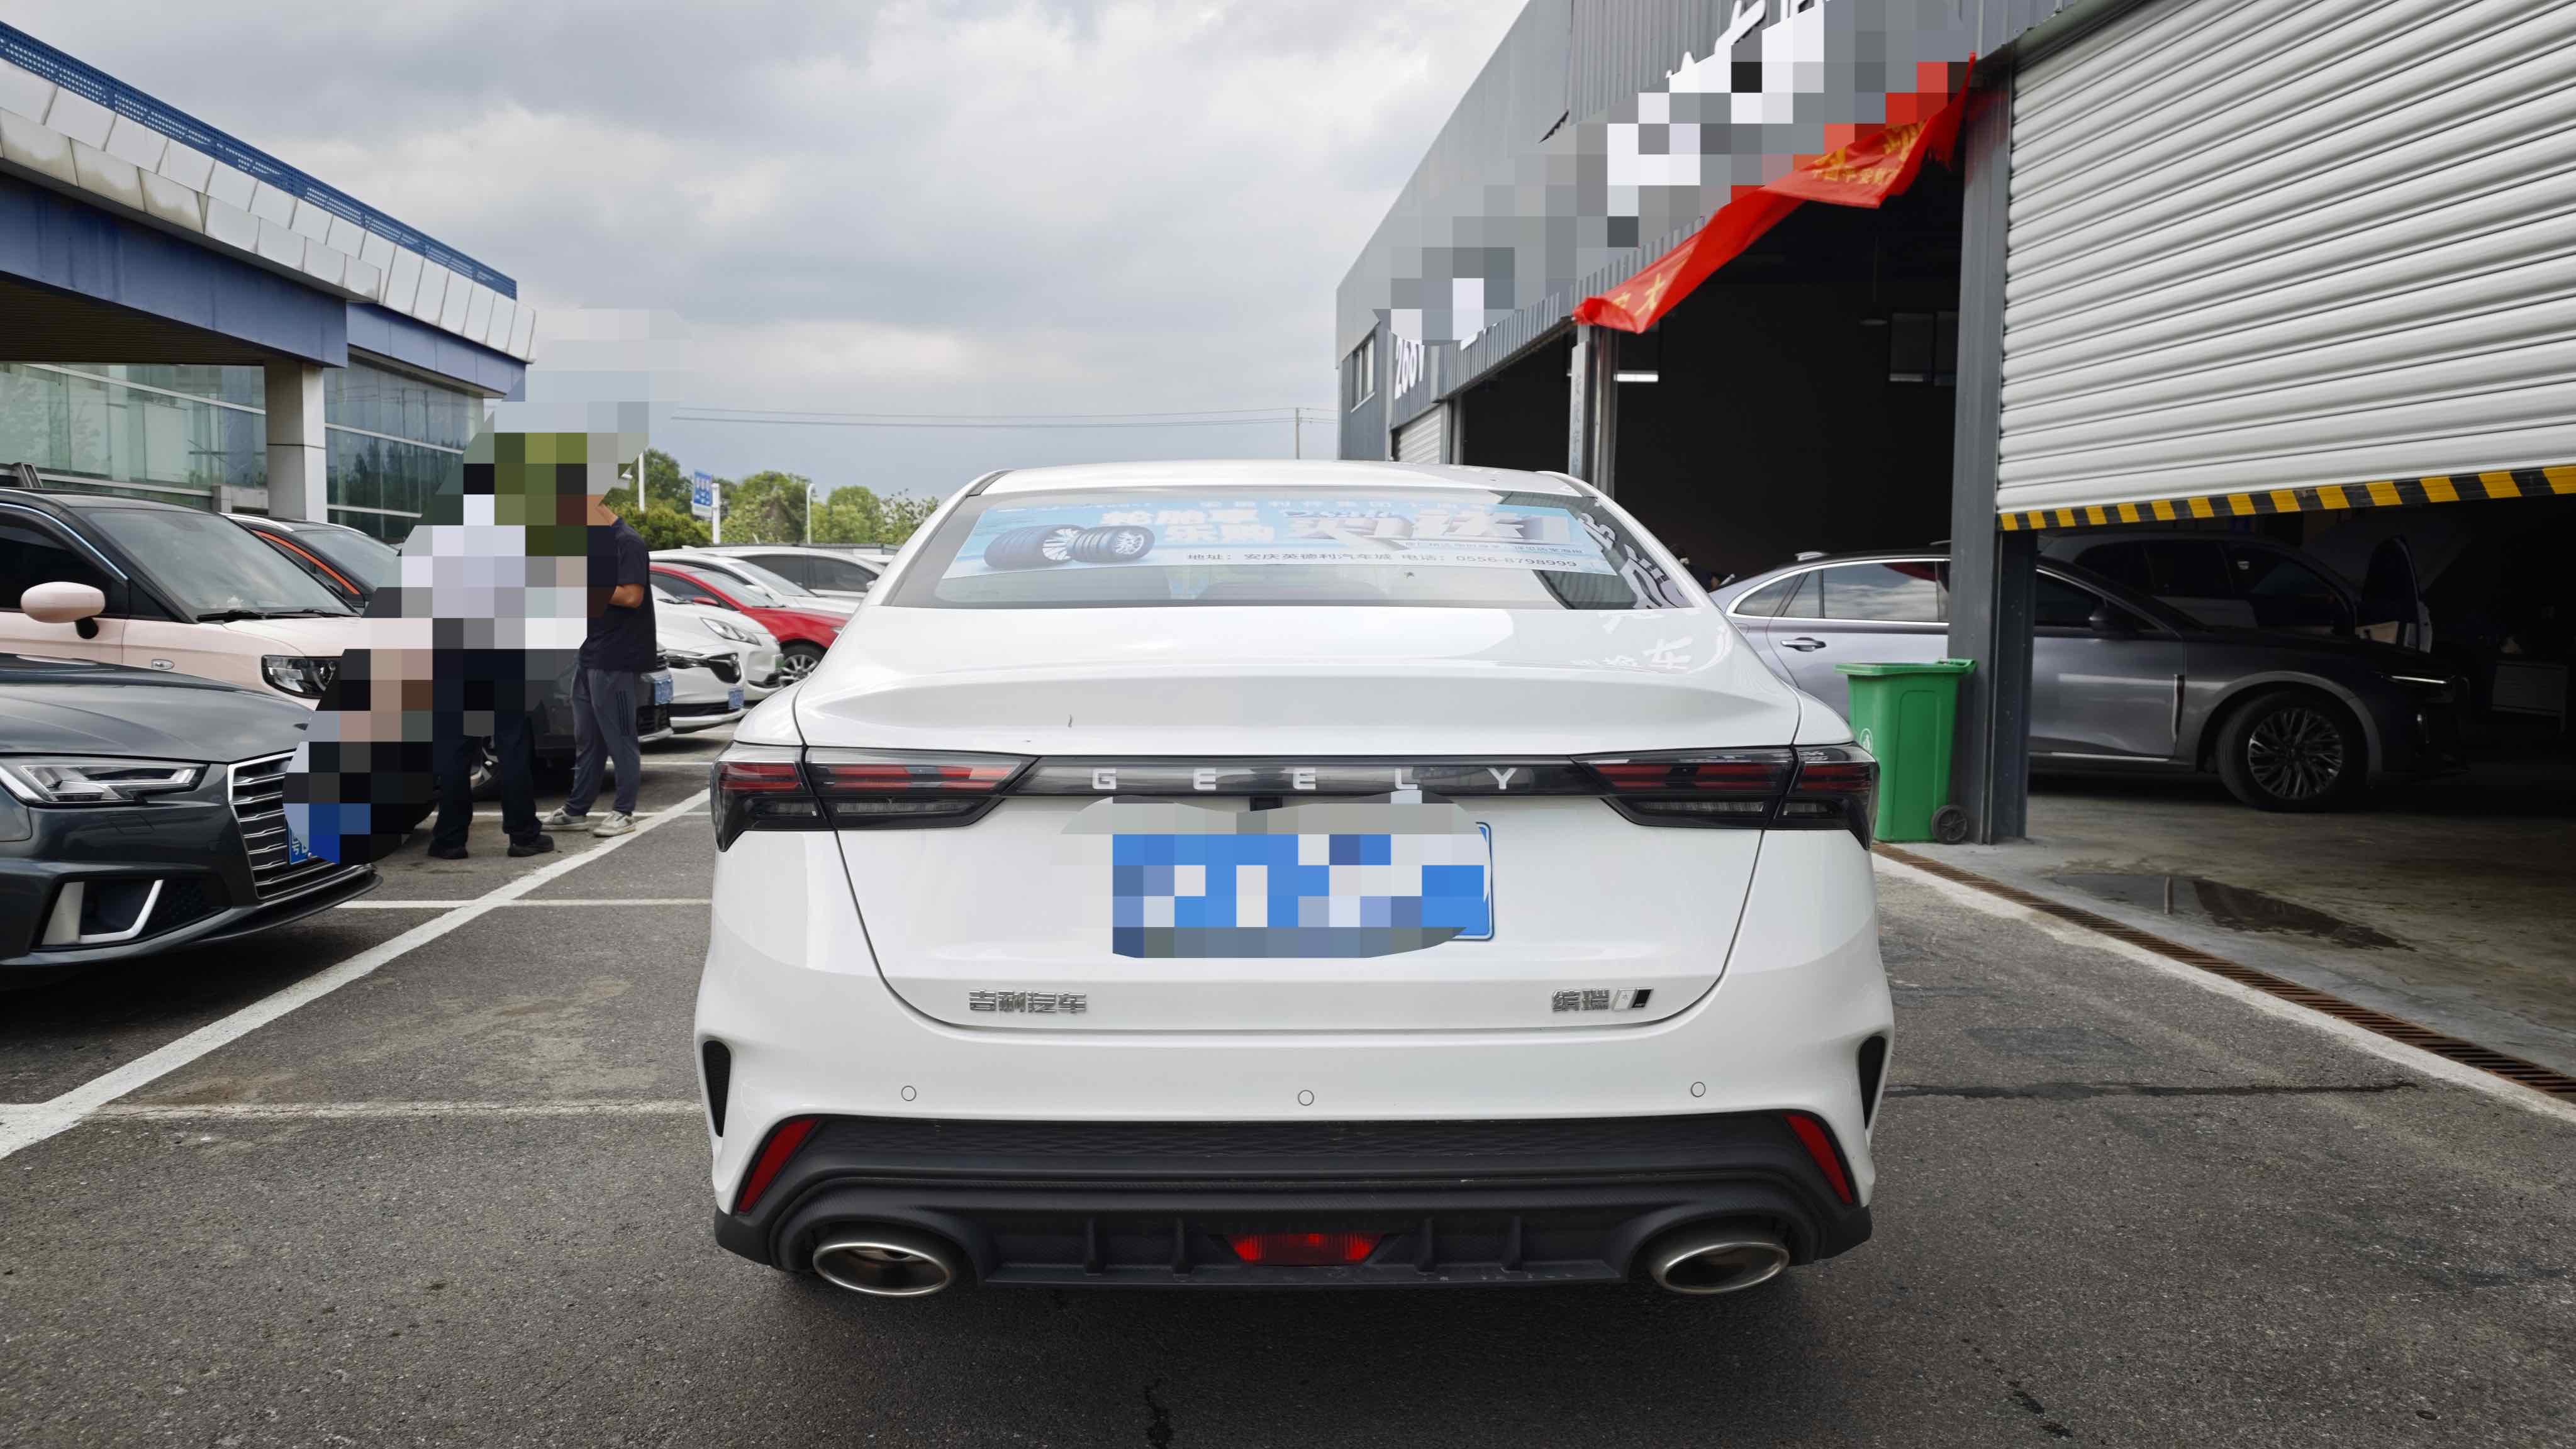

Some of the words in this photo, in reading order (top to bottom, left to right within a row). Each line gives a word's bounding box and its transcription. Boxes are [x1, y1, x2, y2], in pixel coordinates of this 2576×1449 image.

[1091, 768, 1517, 791] GEELY
[968, 989, 1087, 1013] 吉利汽车
